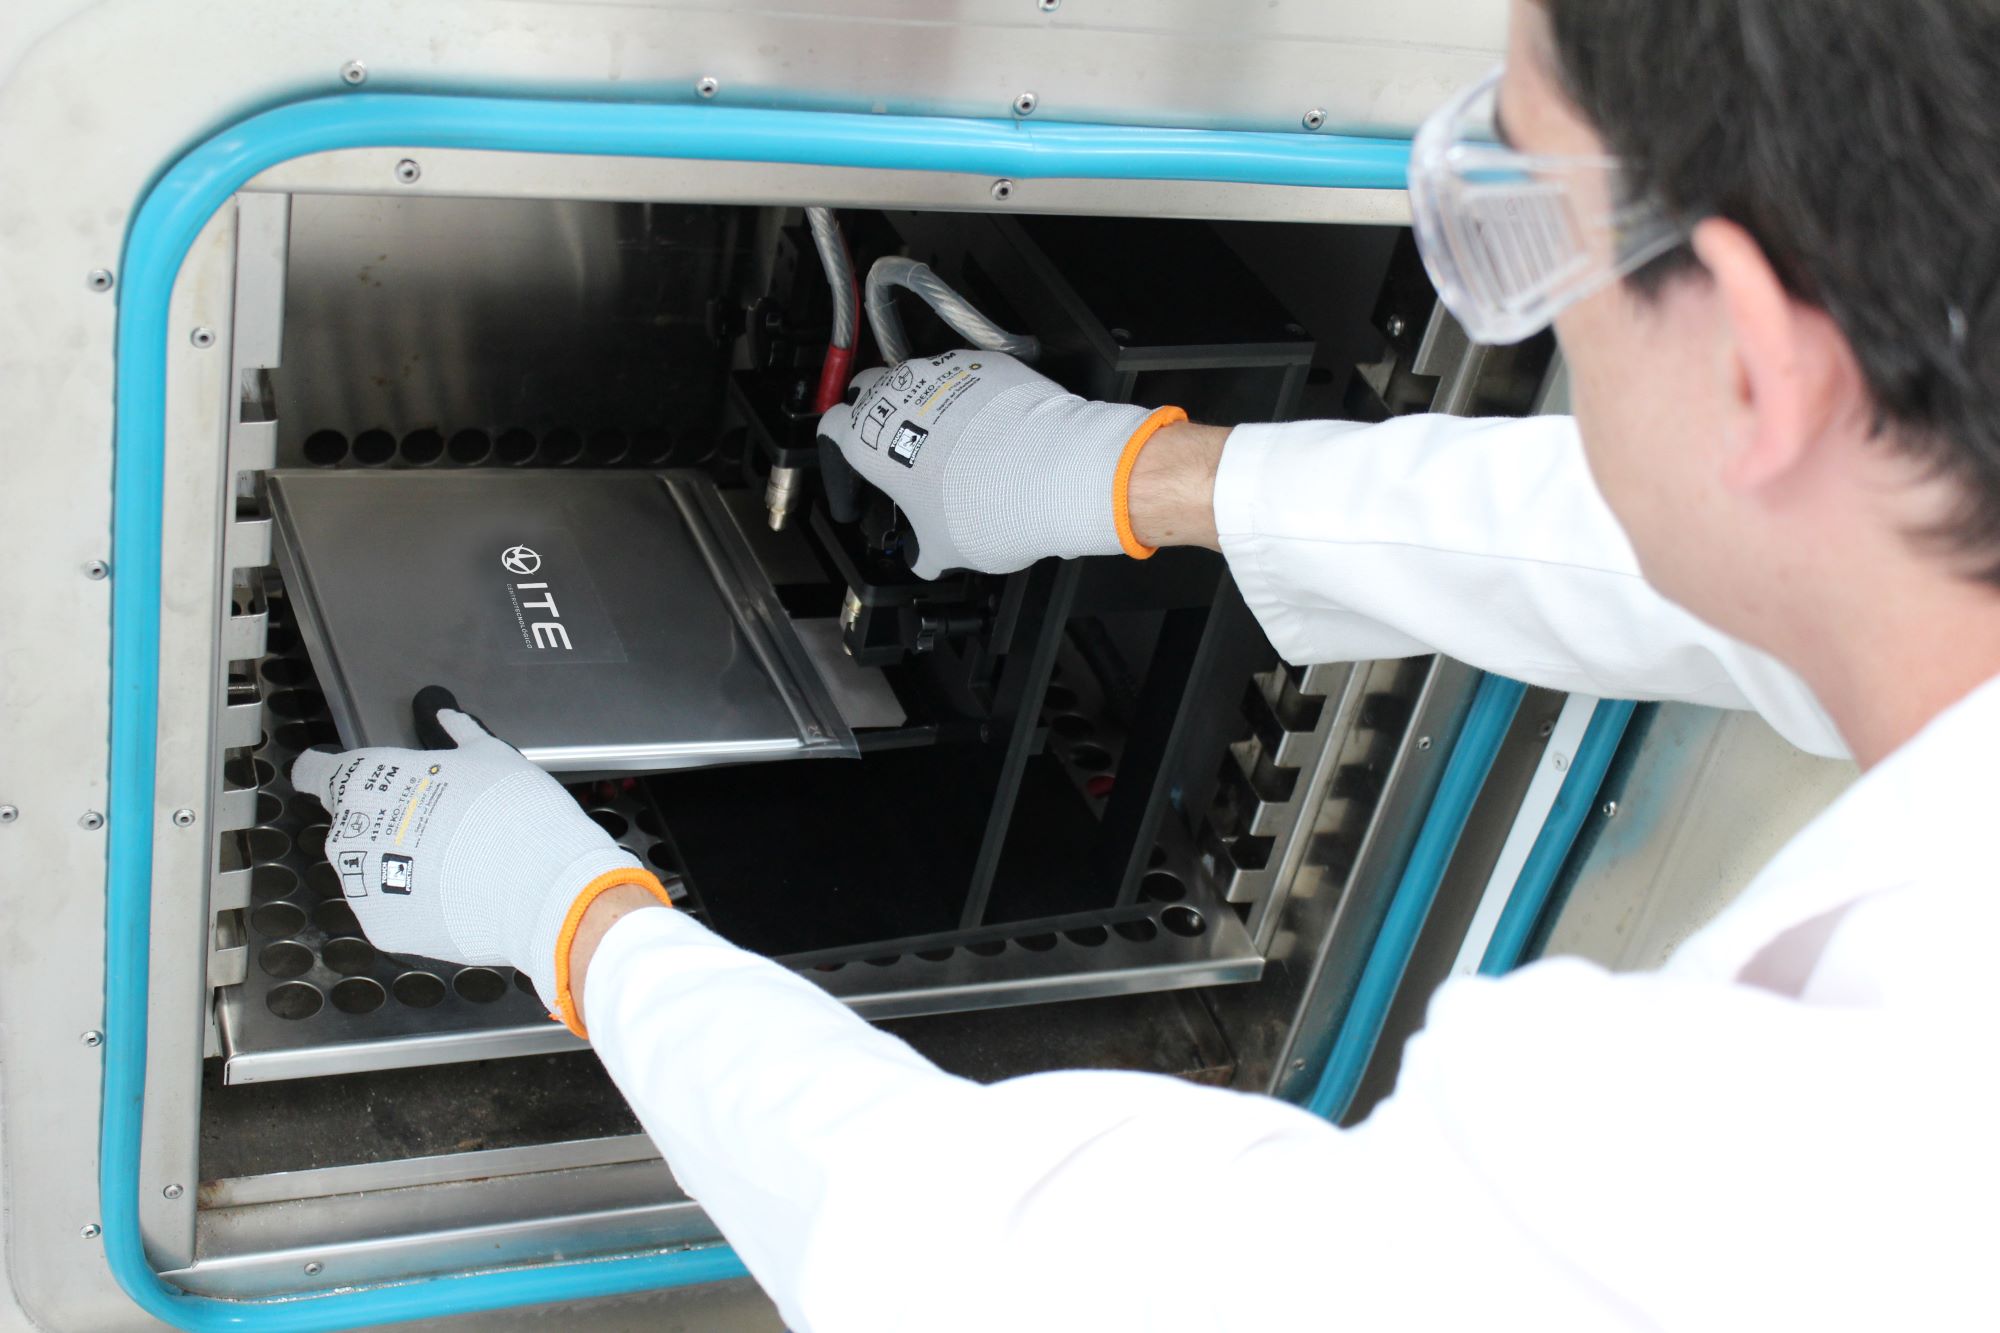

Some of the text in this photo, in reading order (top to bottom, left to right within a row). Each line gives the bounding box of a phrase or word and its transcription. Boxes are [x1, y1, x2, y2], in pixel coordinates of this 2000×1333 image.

[903, 378, 927, 404] 4131X
[890, 427, 905, 448] TOUCH
[908, 433, 928, 465] FUNCTION
[516, 582, 573, 650] ITE
[364, 764, 386, 791] Size
[378, 766, 400, 792] 8/M
[371, 808, 387, 842] 4131X
[405, 860, 413, 892] FUNCTION
